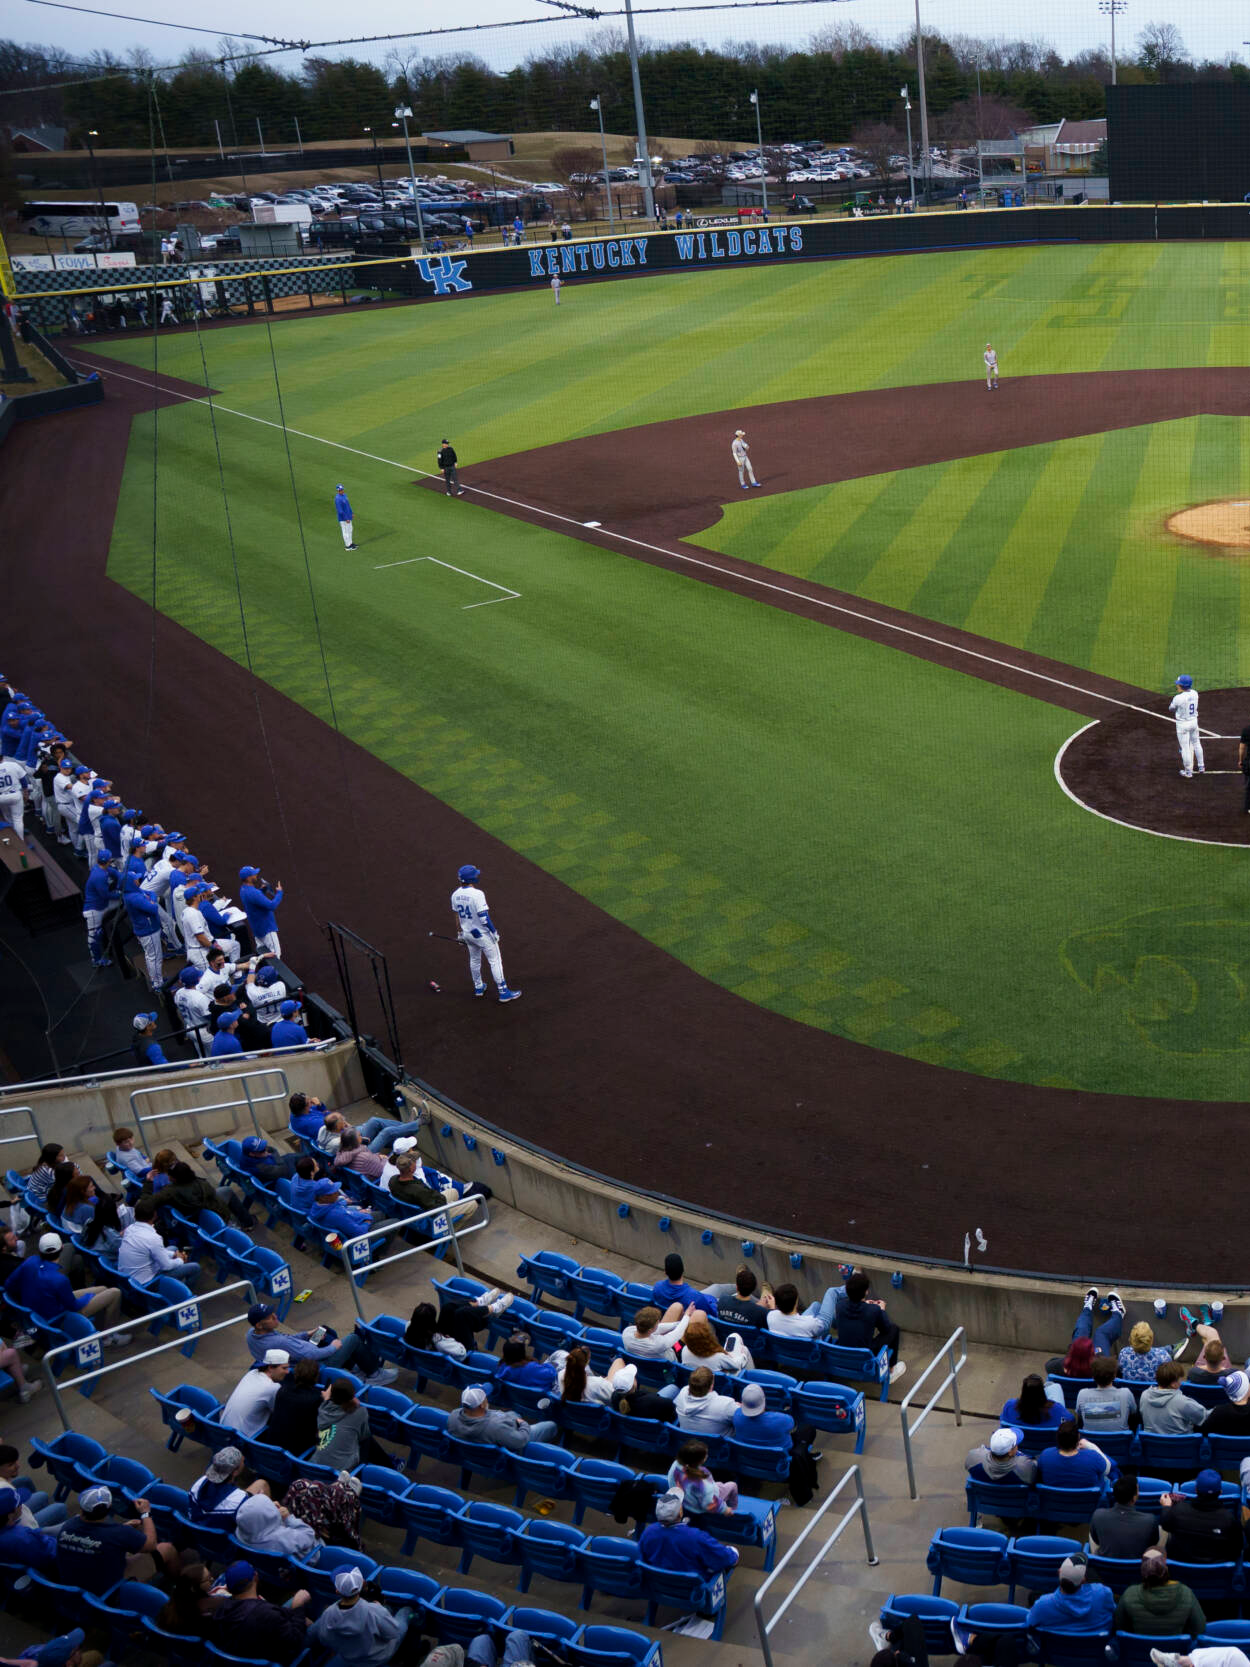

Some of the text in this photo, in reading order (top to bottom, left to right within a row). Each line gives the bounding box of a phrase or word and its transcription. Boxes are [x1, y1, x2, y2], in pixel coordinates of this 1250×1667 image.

[708, 217, 739, 225] LEXUS
[528, 226, 803, 277] KENTUCKY WILDCATS
[415, 255, 473, 295] UK
[1189, 703, 1195, 715] 9
[457, 904, 473, 919] 24
